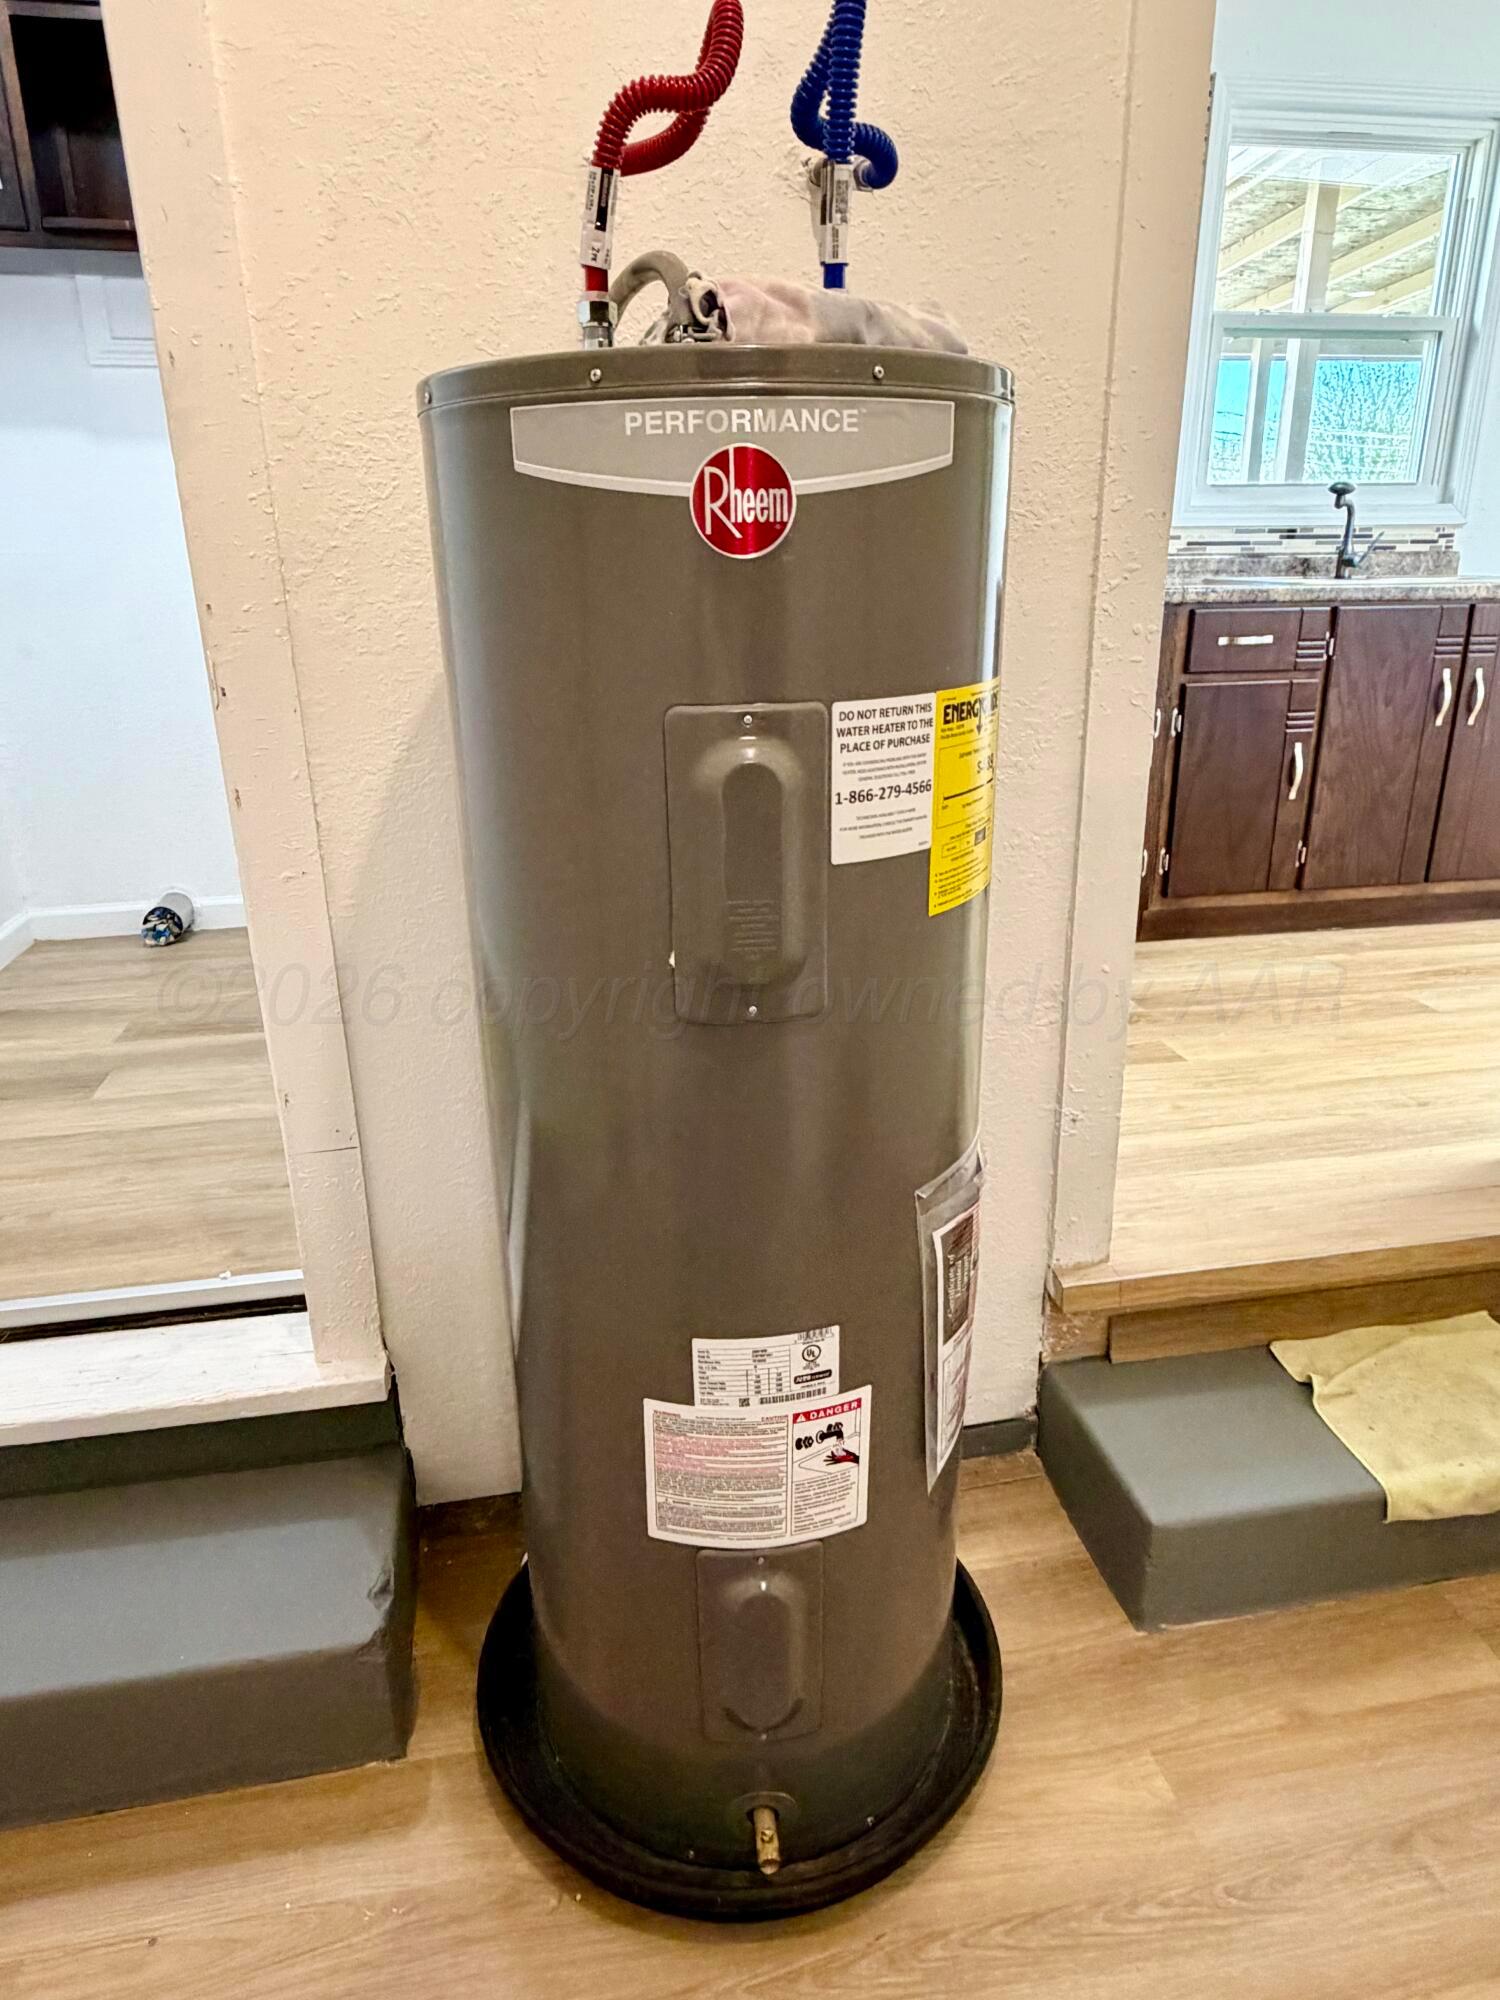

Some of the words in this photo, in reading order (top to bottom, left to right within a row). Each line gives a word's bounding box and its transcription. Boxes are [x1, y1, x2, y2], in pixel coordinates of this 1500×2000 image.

[625, 408, 860, 435] PERFORMANCE
[704, 446, 789, 538] Rheem
[839, 711, 855, 722] DO
[857, 709, 877, 720] NOT
[879, 705, 914, 718] RETURN
[915, 703, 932, 713] THIS
[836, 725, 870, 738] WATER
[872, 721, 906, 735] HEATER
[907, 720, 918, 731] TO
[919, 717, 934, 729] THE
[840, 741, 871, 754] PLACE
[873, 739, 886, 751] OF
[887, 734, 931, 749] PURCHASE
[835, 780, 932, 805] 1-866-279-4566
[809, 1401, 858, 1420] DANGER
